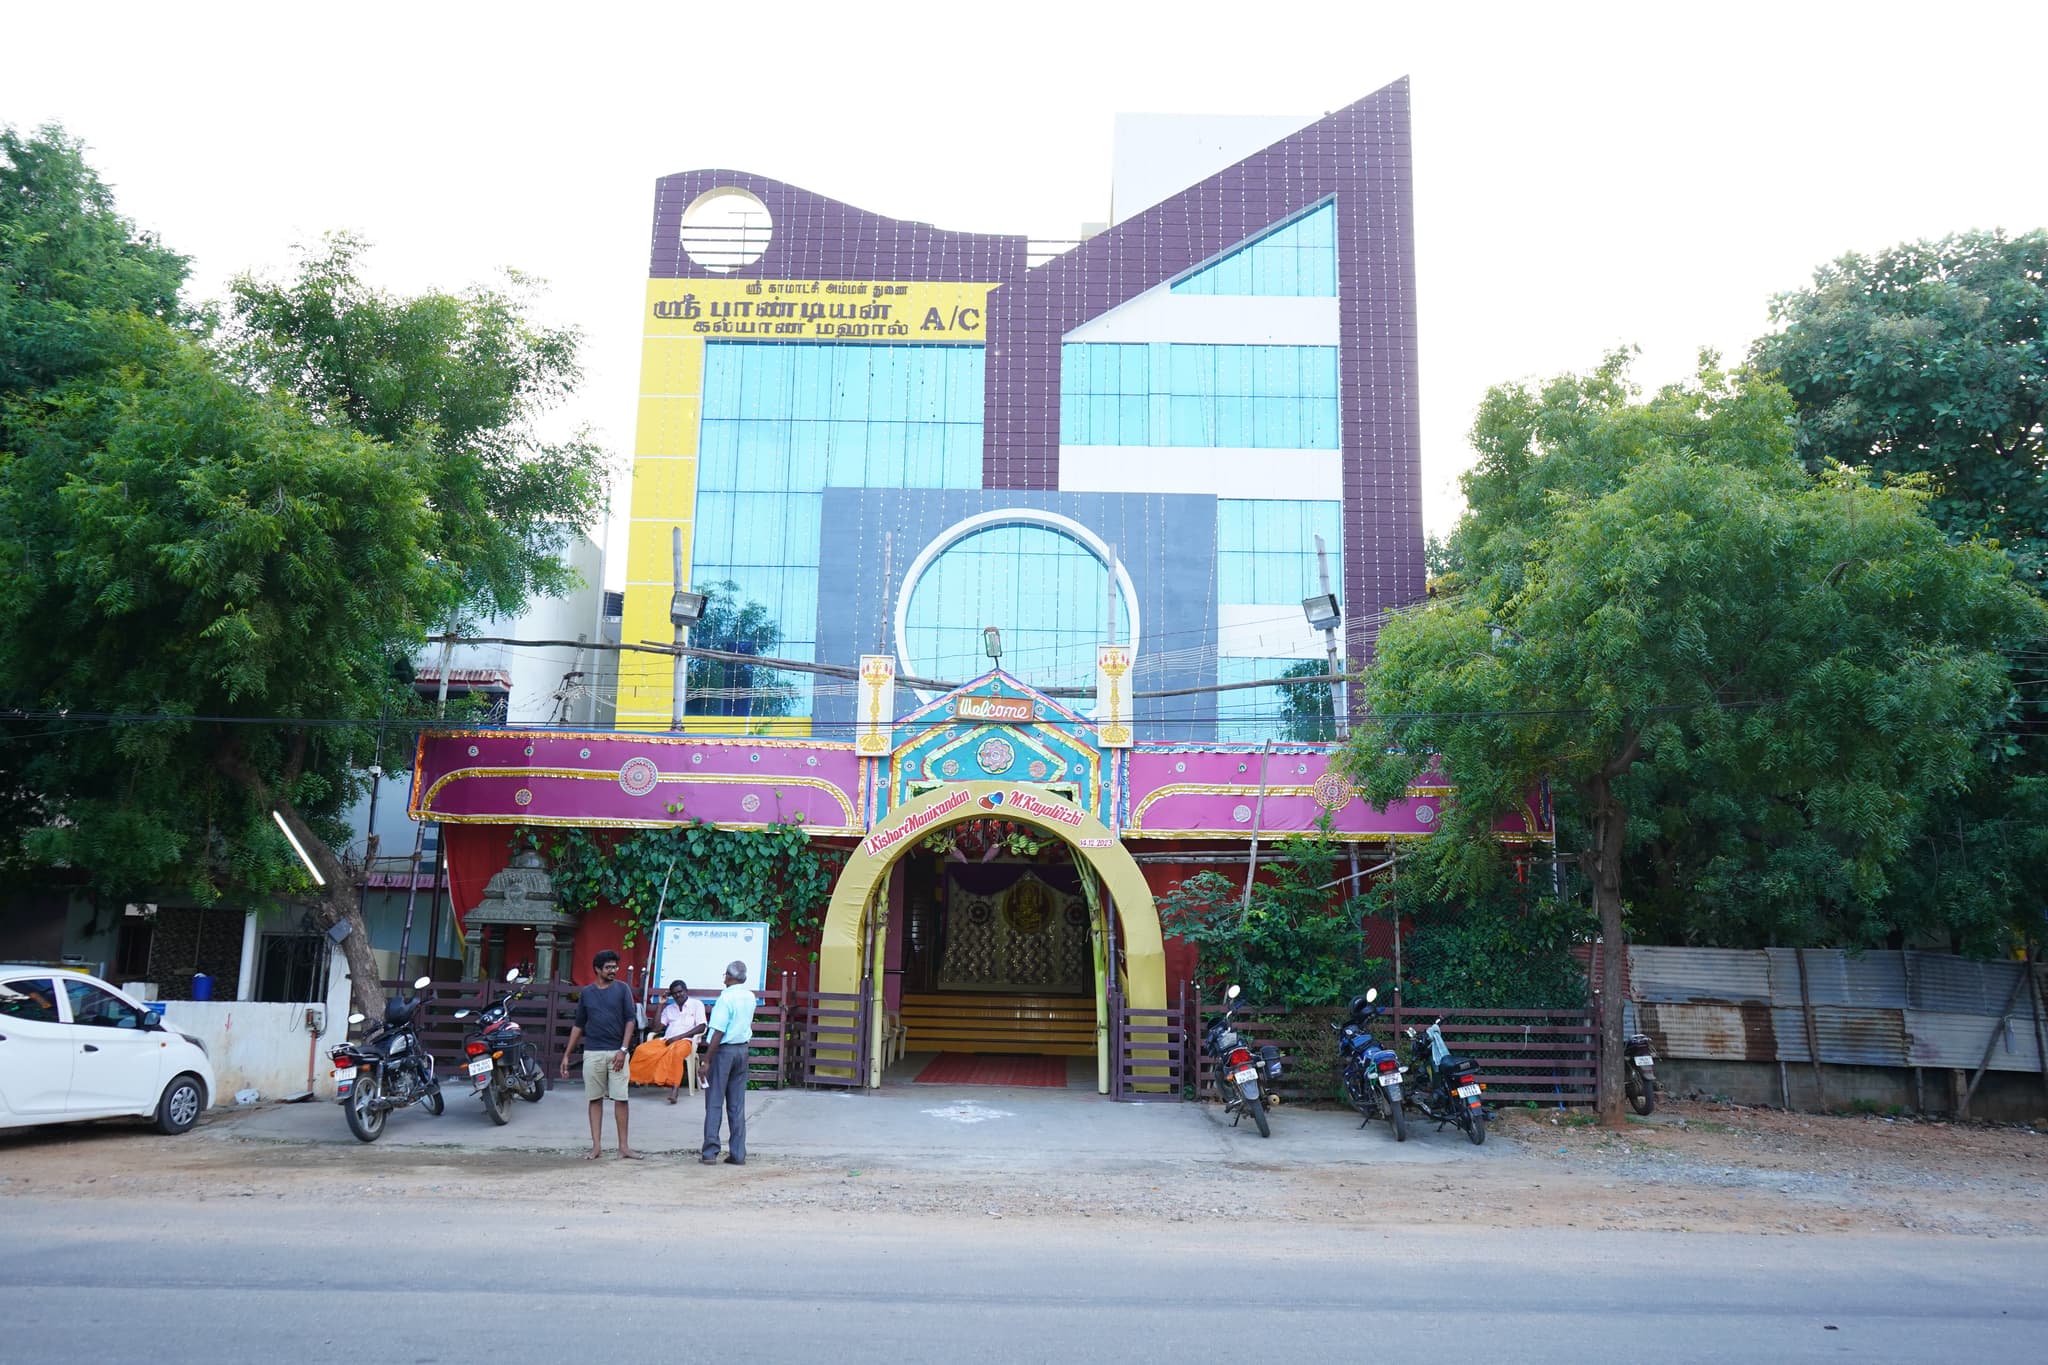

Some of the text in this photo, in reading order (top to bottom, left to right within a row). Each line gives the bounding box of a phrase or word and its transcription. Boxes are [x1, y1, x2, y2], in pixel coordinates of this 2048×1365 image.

[768, 281, 820, 293] காமாட்சி
[825, 282, 868, 295] அம்மன்
[710, 296, 893, 322] பாண்டியன்
[920, 305, 980, 331] A/C
[692, 317, 909, 338] கல்யாண மஹால்
[960, 697, 1029, 719] Welcome
